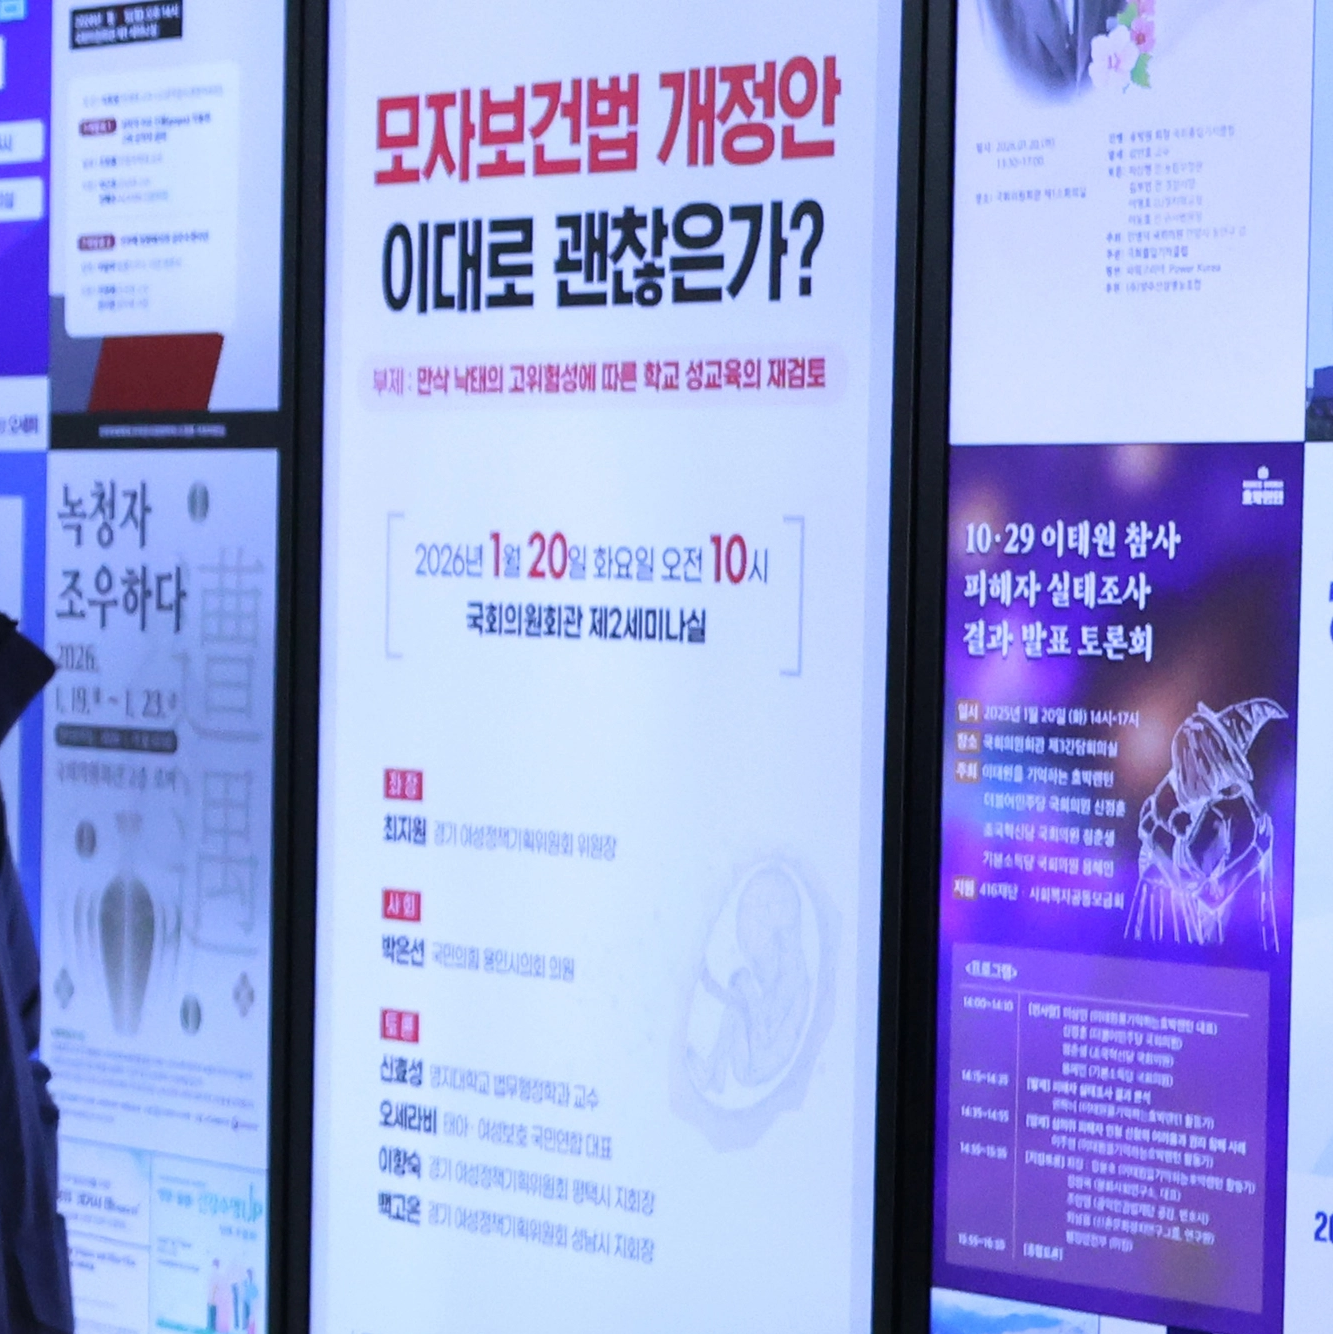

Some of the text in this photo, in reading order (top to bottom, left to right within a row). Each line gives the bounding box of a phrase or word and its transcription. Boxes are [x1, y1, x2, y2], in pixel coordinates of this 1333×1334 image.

[373, 54, 842, 187] 모자보건법 개정안
[381, 197, 825, 315] 이대로 괜찮은가?
[416, 362, 450, 396] 만삭
[453, 362, 504, 395] 낙태의
[509, 361, 597, 394] 고위험성에
[601, 359, 638, 394] 따른
[642, 359, 679, 391] 학교
[685, 357, 761, 391] 성교육의
[766, 356, 827, 390] 재검토
[57, 479, 152, 549] 녹청자
[414, 530, 769, 585] 2026년 1월 20일 화요일 오전 10시
[965, 518, 1182, 561] 10·29 이태원 참사
[55, 563, 187, 633] 조우하다
[963, 568, 1152, 611] 피해자 실태조사
[466, 601, 707, 644] 국회의원회관 제2세미나실
[963, 618, 1154, 663] 결과 발표 토론회
[383, 812, 427, 846] 최지원
[379, 1099, 437, 1135] 오세라비
